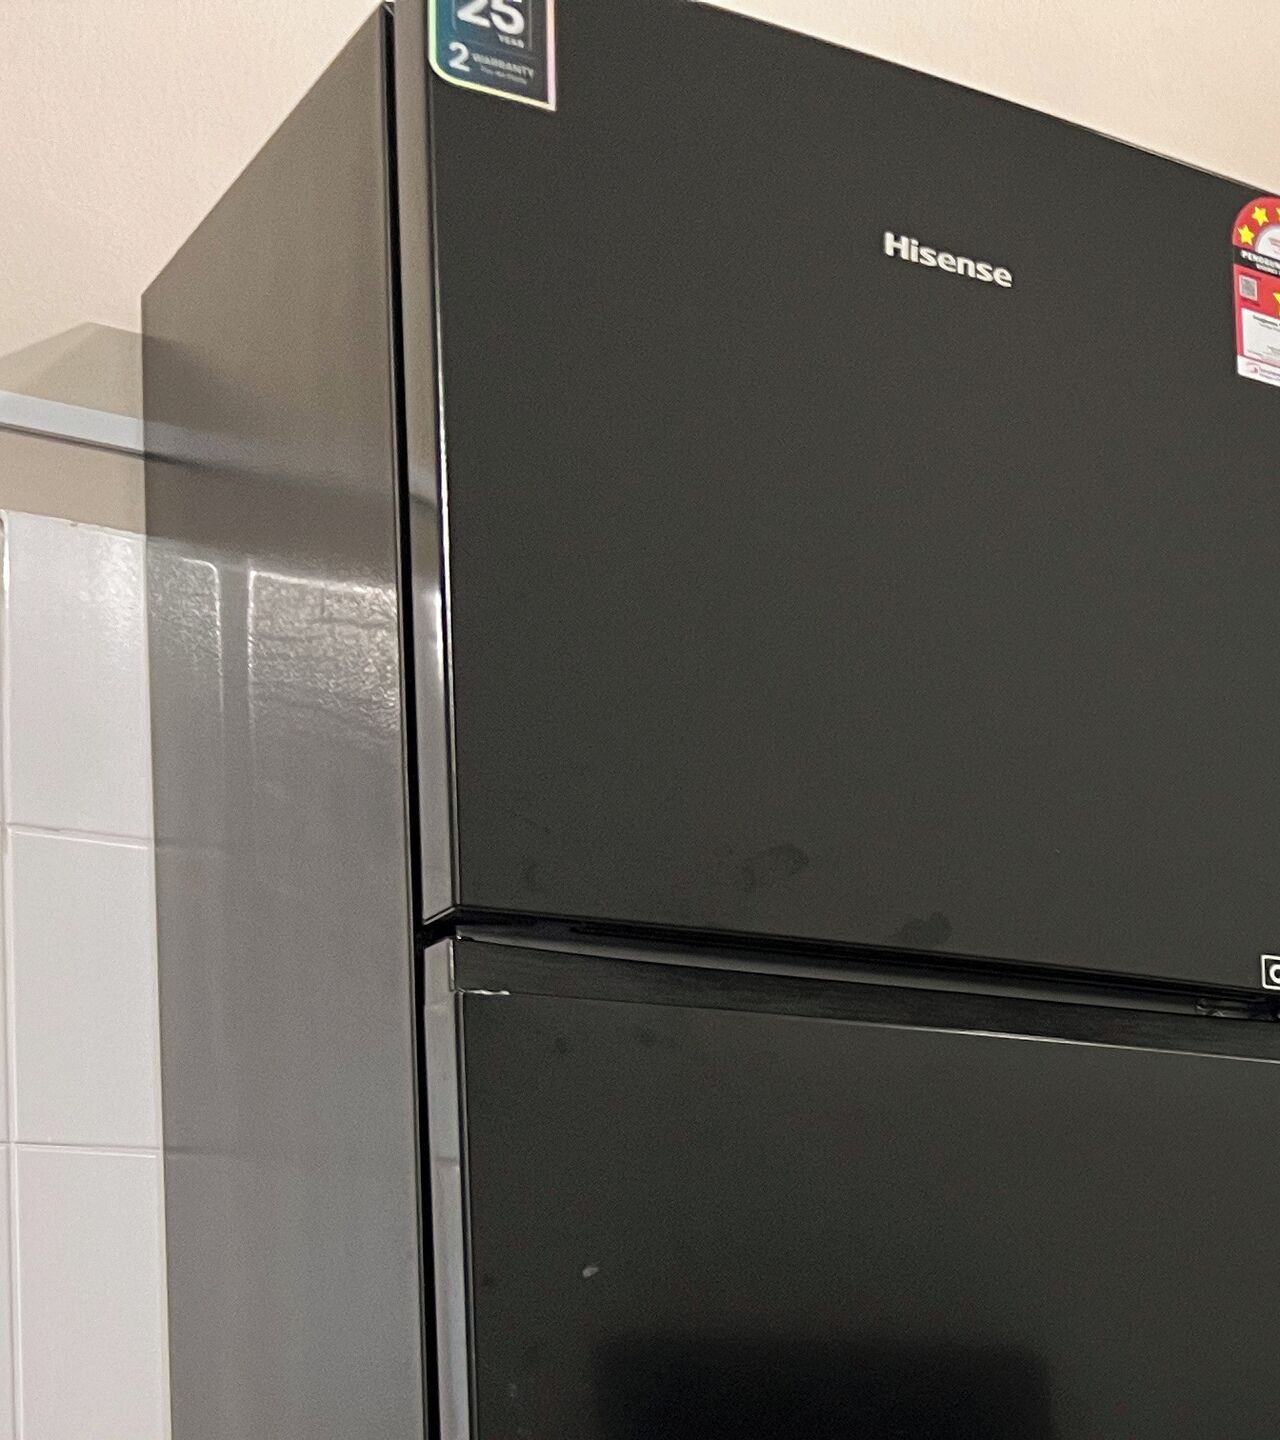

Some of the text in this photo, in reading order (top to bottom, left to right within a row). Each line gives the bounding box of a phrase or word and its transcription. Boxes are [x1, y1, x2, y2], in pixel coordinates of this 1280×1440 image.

[456, 0, 525, 35] 25
[449, 41, 470, 72] 2
[884, 231, 1013, 288] Hisense
